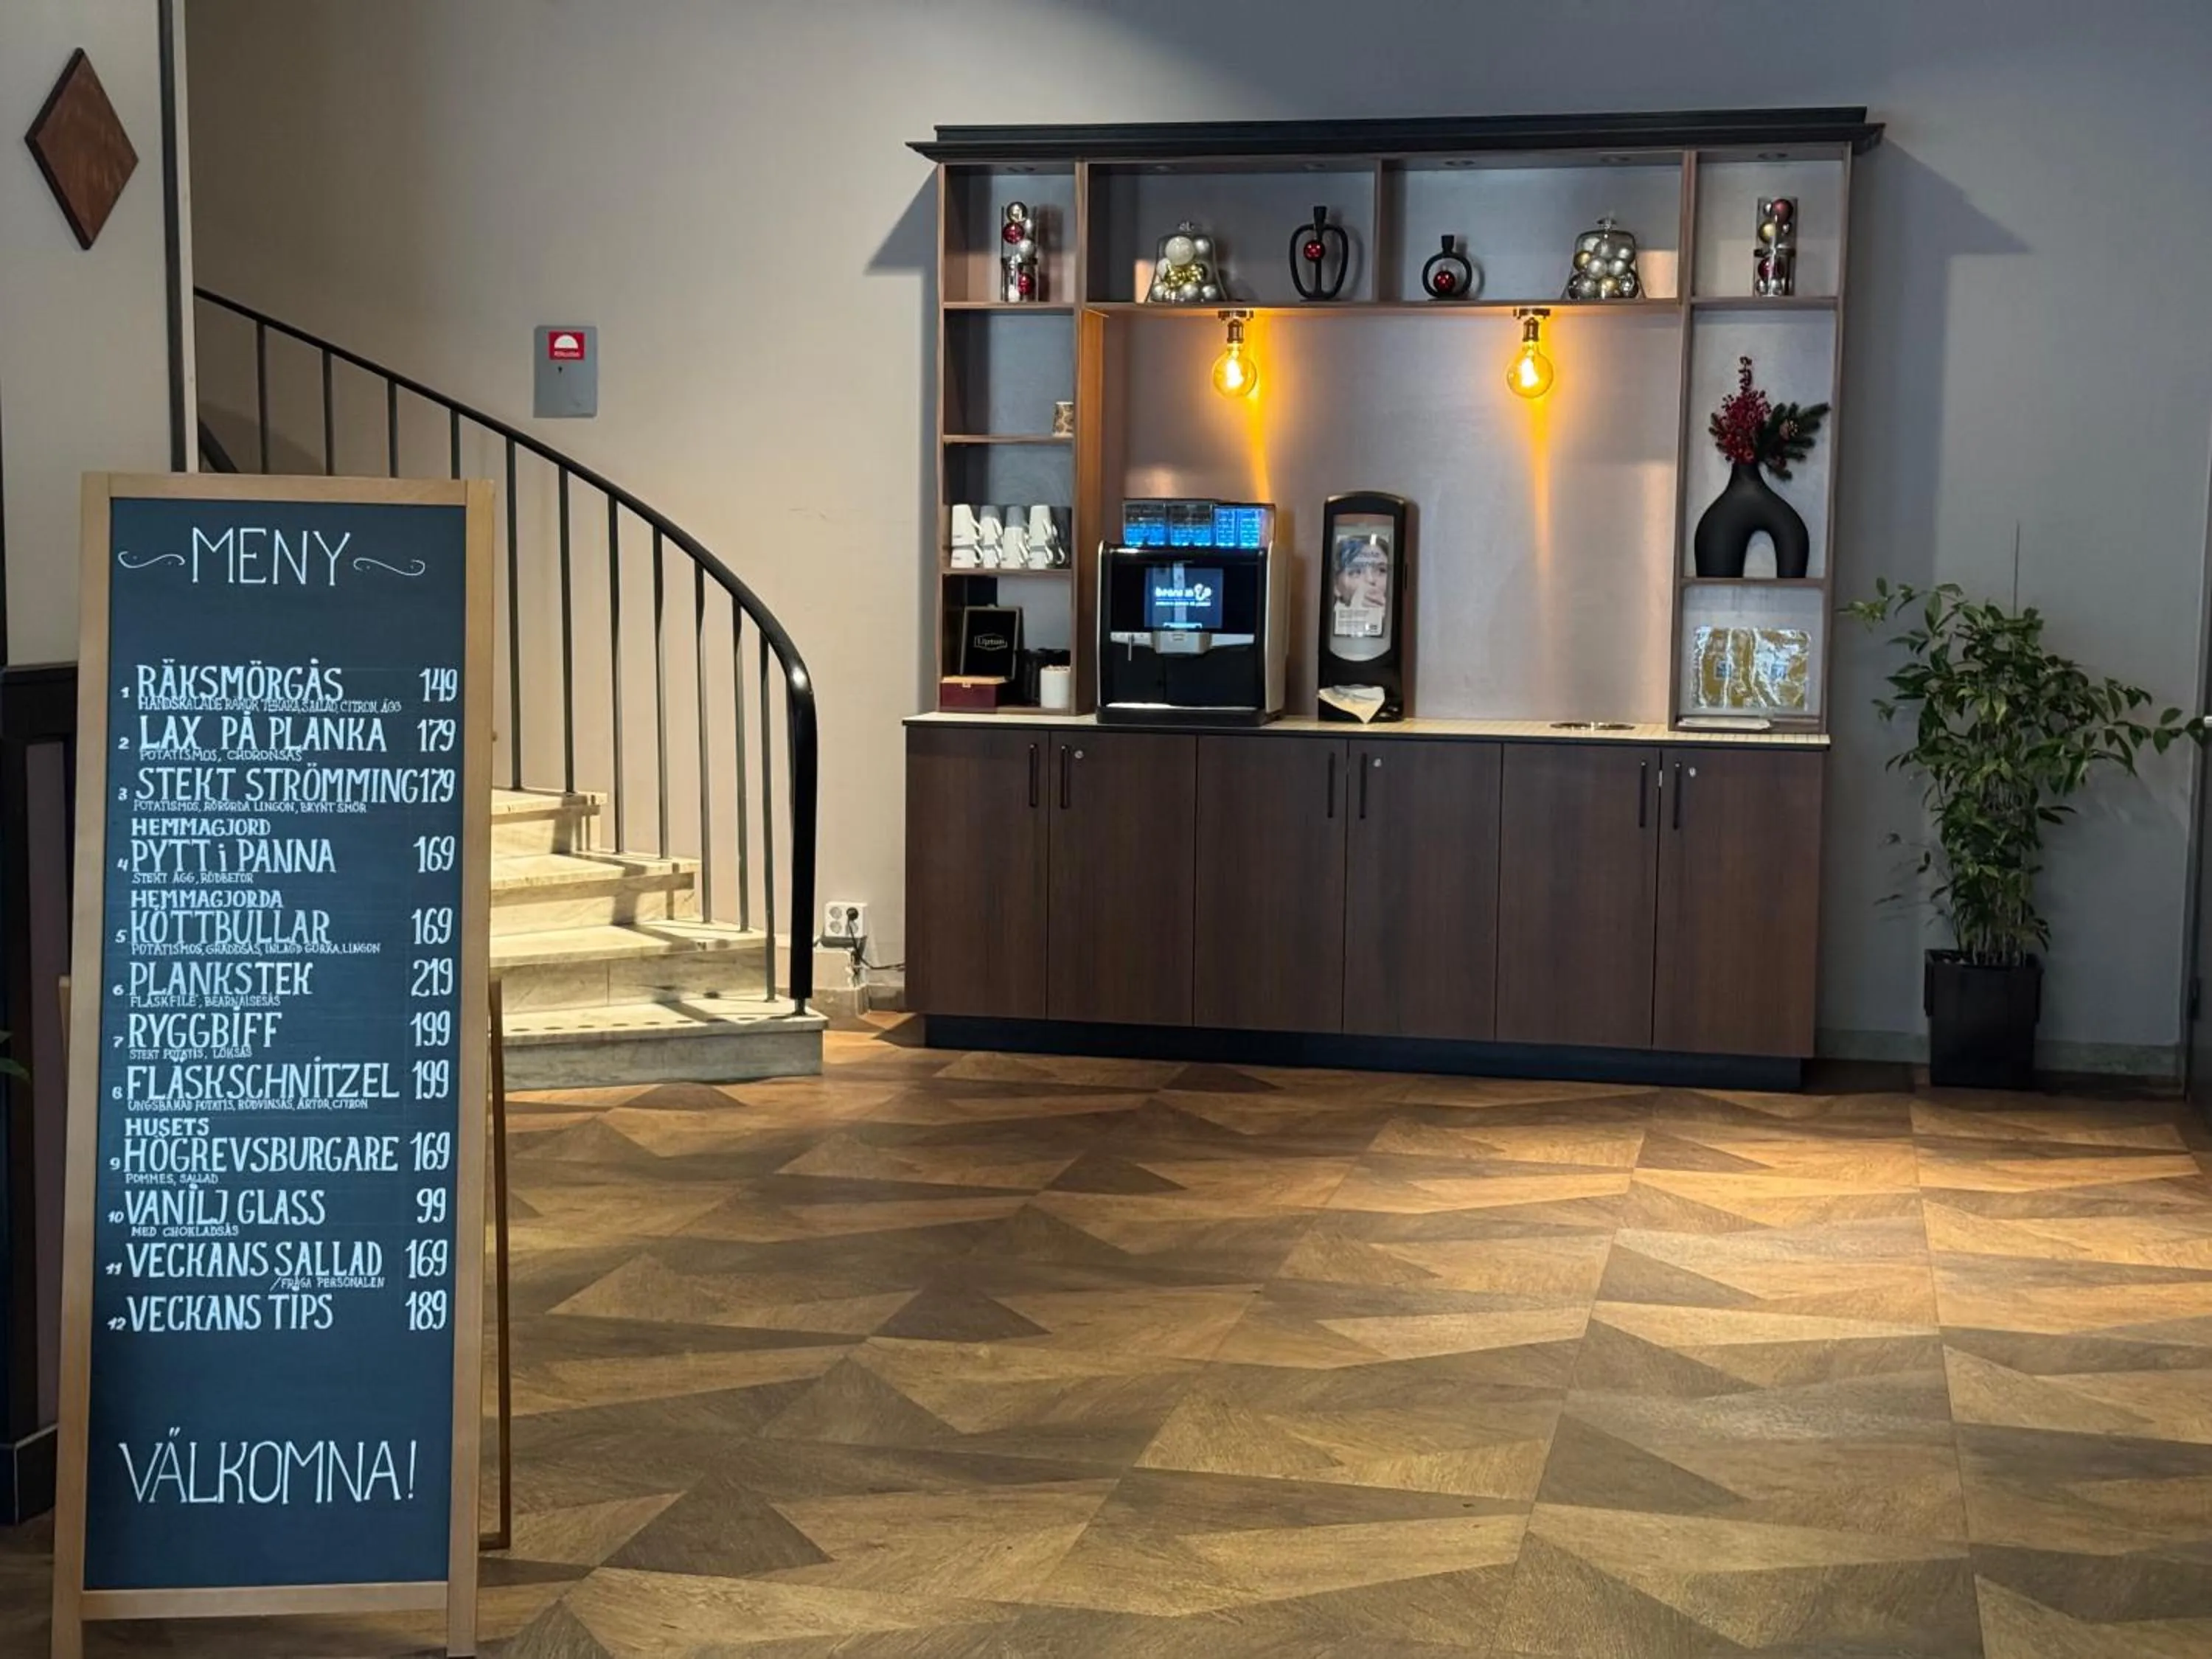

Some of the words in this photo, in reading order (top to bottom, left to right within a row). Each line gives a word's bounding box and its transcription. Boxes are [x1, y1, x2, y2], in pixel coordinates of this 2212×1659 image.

[192, 526, 350, 586] MENY
[119, 686, 130, 698] 1
[136, 658, 344, 702] RÄKSMÖRGÅS
[418, 667, 459, 703] 149
[118, 737, 130, 750] 2
[139, 714, 203, 751] LAX
[220, 710, 259, 751] PÅ
[268, 715, 388, 753] PLANKA
[417, 718, 456, 753] 179
[117, 787, 128, 801] 3
[135, 767, 237, 801] STEKT
[245, 762, 419, 804] STRÖMMING
[419, 768, 456, 803] 179
[131, 817, 271, 837] HEMMAGJORD
[117, 858, 129, 872] 4
[130, 838, 212, 873] PYTT
[235, 838, 338, 874] PANNA
[412, 835, 456, 873] 169
[130, 888, 284, 910] HEMMAGJORDA
[115, 930, 128, 944] 5
[130, 908, 332, 945] KÖTTBULLAR
[411, 906, 453, 945] 169
[112, 984, 125, 996] 6
[129, 961, 313, 996] PLANKSTEK
[411, 957, 453, 997] 219
[113, 1036, 125, 1048] 7
[409, 1009, 451, 1048] 199
[411, 1059, 450, 1100] 199
[124, 1116, 210, 1137] HUSETS
[110, 1157, 121, 1170] 9
[123, 1134, 400, 1173] HÖGREVSBURGARE
[409, 1130, 451, 1172] 169
[178, 1173, 219, 1184] SALLAD
[108, 1210, 125, 1224] 10
[237, 1188, 326, 1225] GLASS
[416, 1187, 447, 1224] 99
[131, 1225, 157, 1237] MED
[105, 1262, 123, 1276] 11
[125, 1242, 270, 1278] VECKANS
[274, 1241, 383, 1278] SALLAD
[405, 1239, 448, 1279] 169
[316, 1276, 386, 1289] PERSONALEN
[106, 1316, 127, 1332] 12
[125, 1294, 262, 1332] VECKANS
[267, 1286, 335, 1331] TIPS
[405, 1290, 448, 1332] 189
[118, 1426, 417, 1505] VÄLKOMNA!
